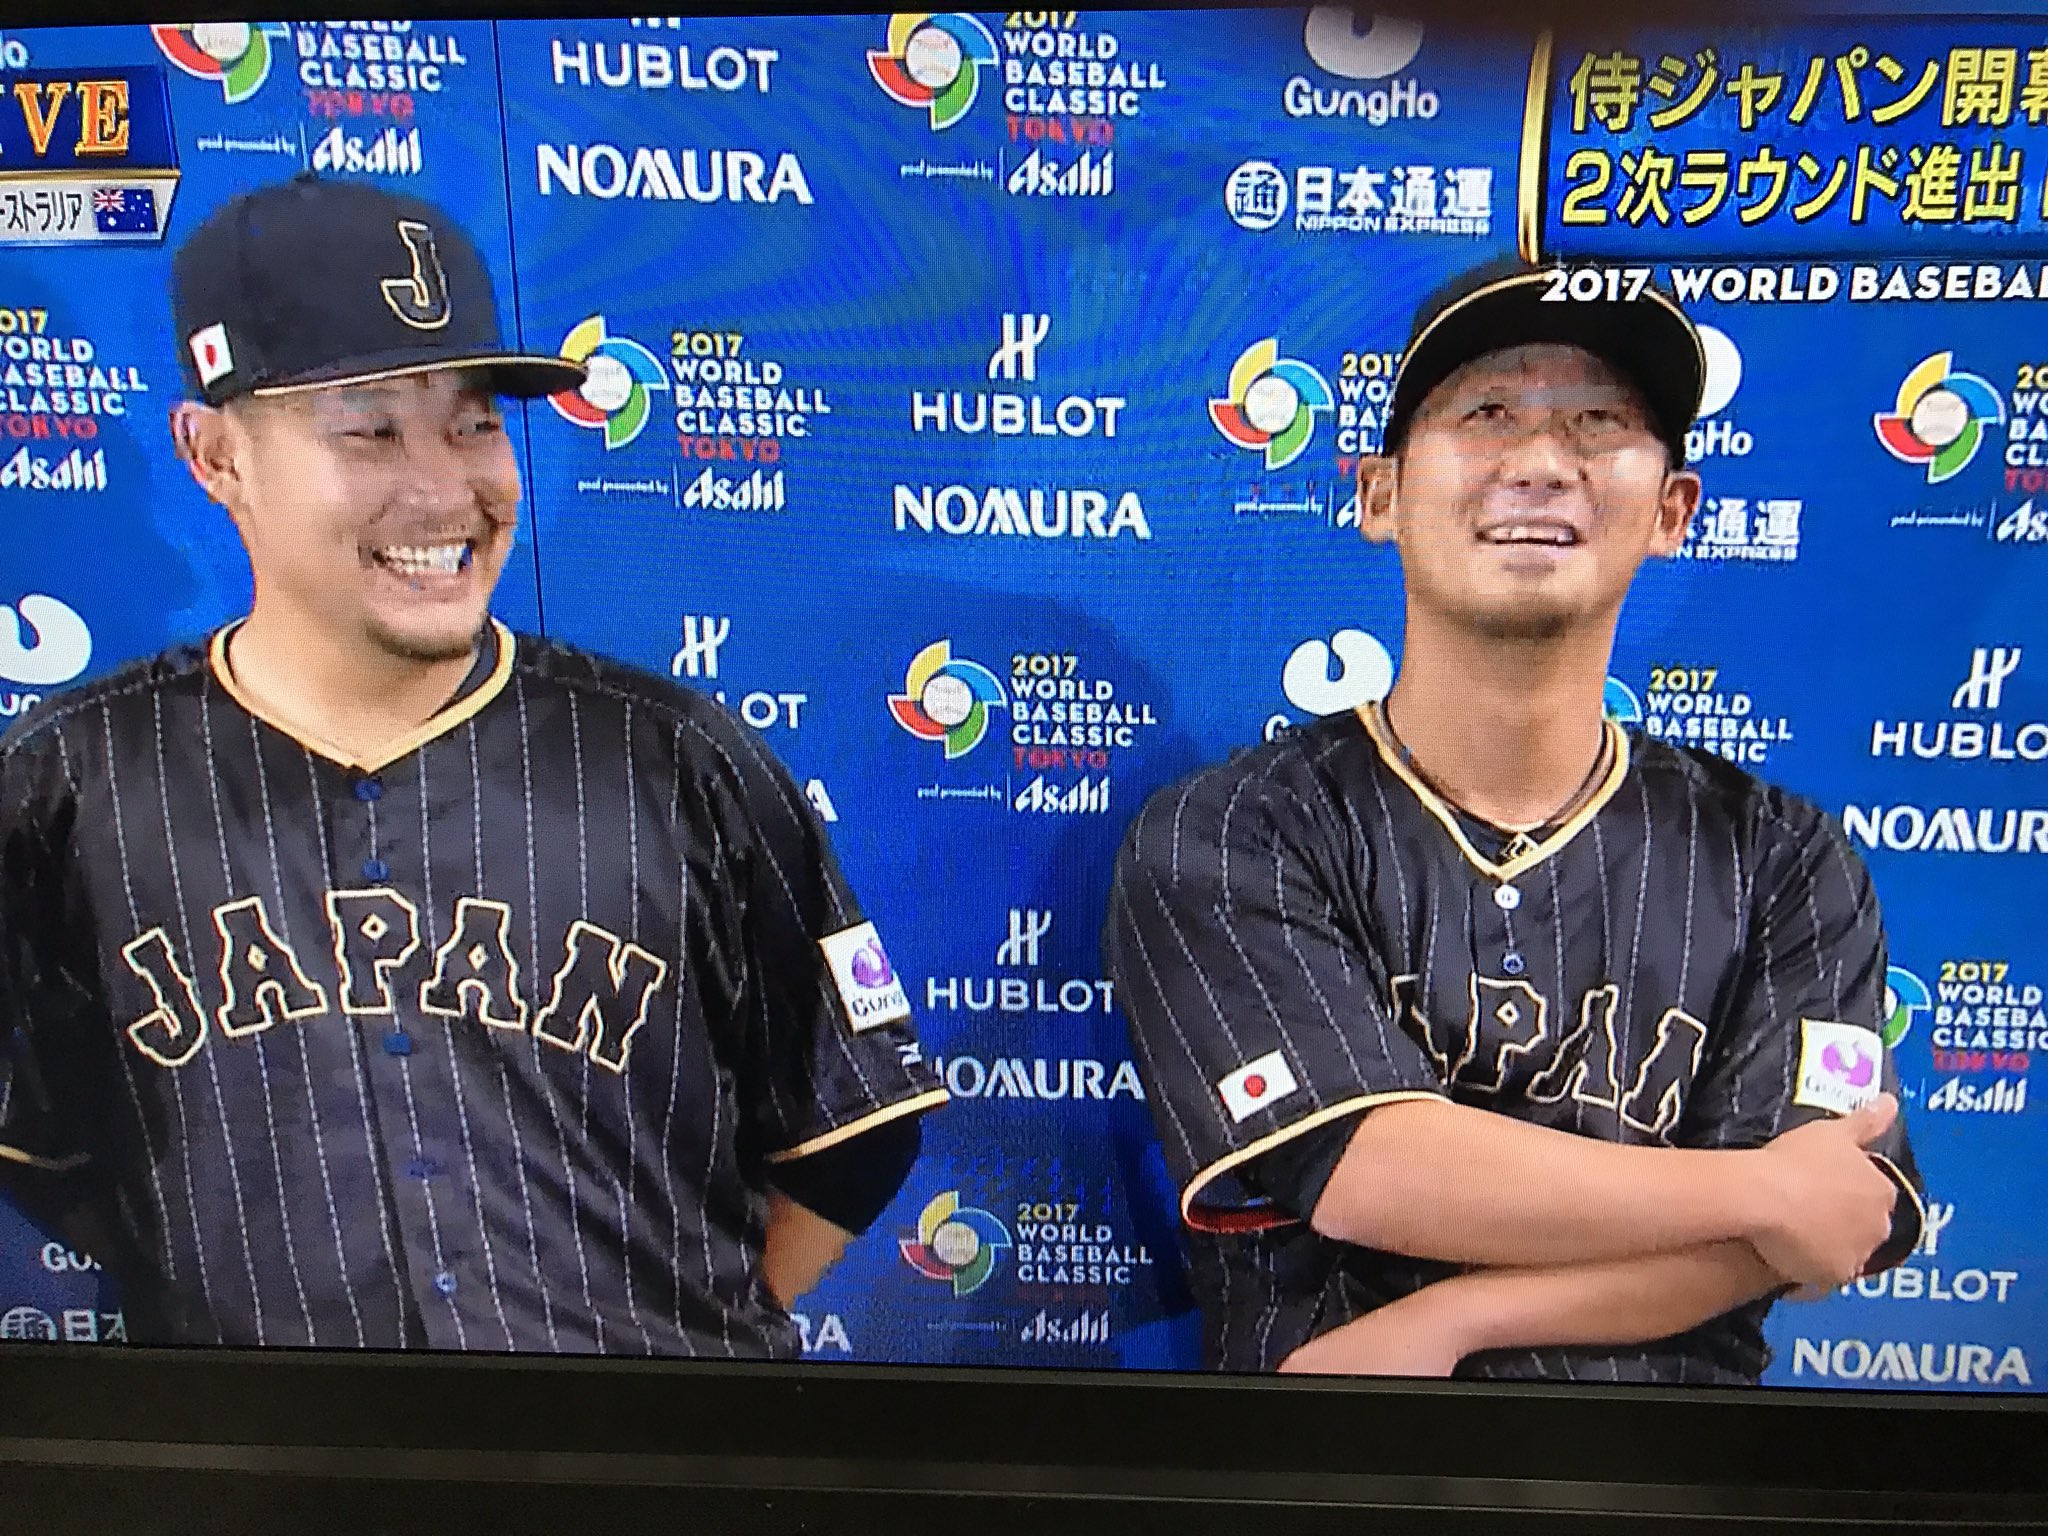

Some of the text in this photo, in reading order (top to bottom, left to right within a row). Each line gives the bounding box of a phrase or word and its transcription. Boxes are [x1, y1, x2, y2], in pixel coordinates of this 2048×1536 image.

[297, 31, 466, 67] BASEBALL
[1002, 31, 1119, 60] WORLD
[299, 60, 444, 93] CLASSIC
[551, 39, 779, 95] HUBLOT
[1004, 60, 1167, 89] BASEBALL
[1004, 88, 1141, 116] CLASSIC
[1283, 75, 1440, 127] GungHo
[0, 81, 130, 157] VE
[311, 126, 424, 177] Asahi
[537, 143, 815, 206] NOMURA
[1007, 147, 1115, 197] Asahi
[1562, 141, 2048, 226] 2次ラウンド進出
[1296, 165, 1493, 218] 日本通運
[380, 219, 452, 331] J
[1540, 267, 1653, 302] 2017
[1670, 267, 1840, 302] WORLD
[0, 335, 95, 363] ORLD
[671, 332, 744, 358] 2017
[0, 363, 149, 392] ASEBALL
[670, 358, 784, 385] WORLD
[675, 383, 832, 414] BASEBALL
[911, 390, 1127, 438] HUBLOT
[676, 409, 808, 438] CLASSIC
[1, 445, 108, 491] Asahi
[683, 466, 786, 512] Asahi
[893, 483, 1152, 541] NOMURA
[1686, 498, 1803, 545] 通運
[1012, 655, 1078, 679] 2017
[1649, 667, 1719, 692] 2017
[1010, 679, 1113, 702] WORLD
[1645, 692, 1752, 716] WORLD
[1011, 701, 1157, 726] BASEBALL
[1645, 716, 1794, 740] BASEBALL
[1011, 725, 1134, 748] CLASSIC
[1014, 774, 1111, 814] Asahi
[122, 887, 669, 1073] JAPAN
[1940, 961, 2010, 983] 2017
[926, 976, 1115, 1014] HUBLOT
[1937, 982, 2044, 1006] WORLD
[1928, 1075, 2028, 1114] Asahi
[1016, 1203, 1079, 1222] 2017
[1015, 1223, 1114, 1244] WORLD
[1017, 1244, 1153, 1265] BASEBALL
[1017, 1264, 1131, 1285] CLASSIC
[1842, 1265, 2019, 1304] UBLOT
[1792, 1337, 2032, 1386] NOMURA
